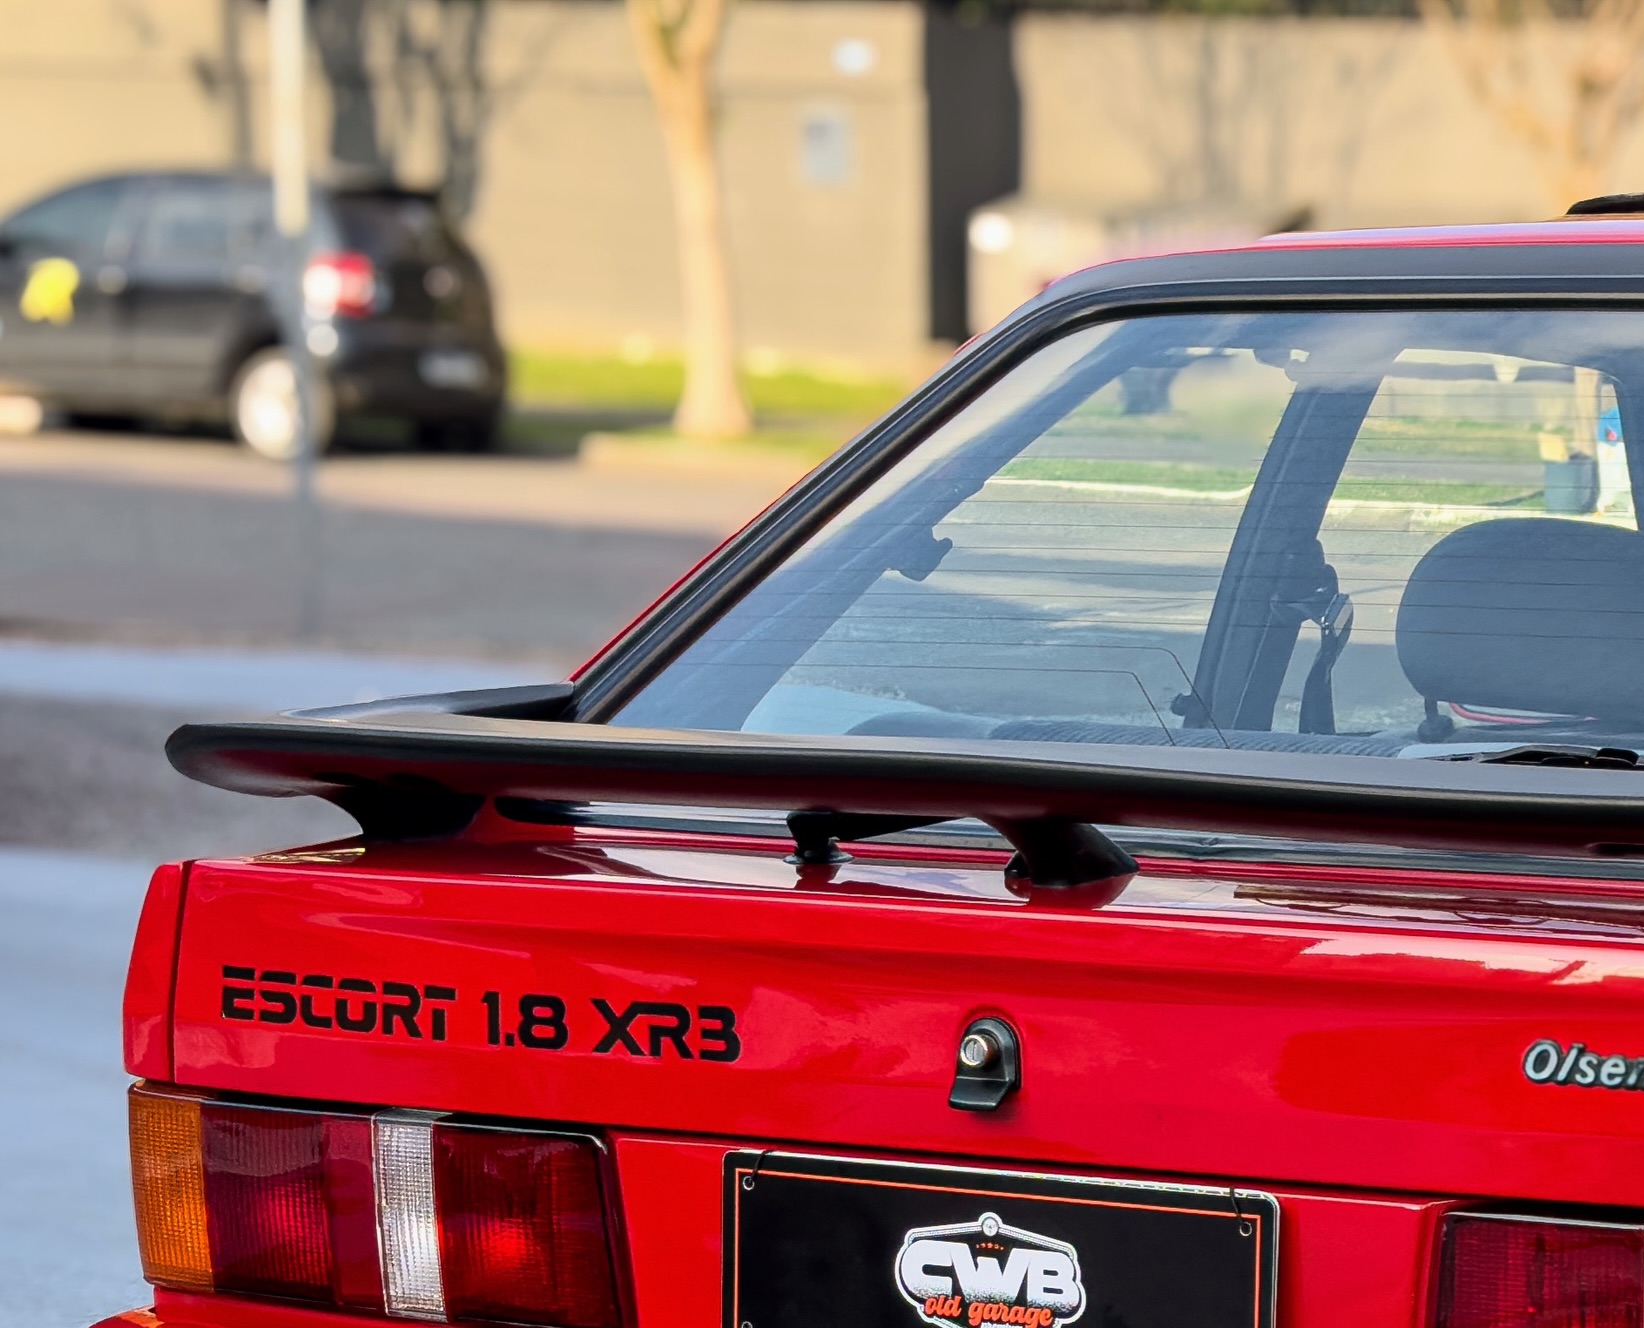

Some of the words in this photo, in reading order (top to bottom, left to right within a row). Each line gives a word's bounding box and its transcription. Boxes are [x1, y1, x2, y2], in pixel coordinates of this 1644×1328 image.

[221, 964, 457, 1042] ESCORT
[481, 991, 569, 1051] 1.8
[590, 997, 742, 1063] XR3
[901, 1239, 1081, 1313] CWB
[924, 1295, 962, 1318] old
